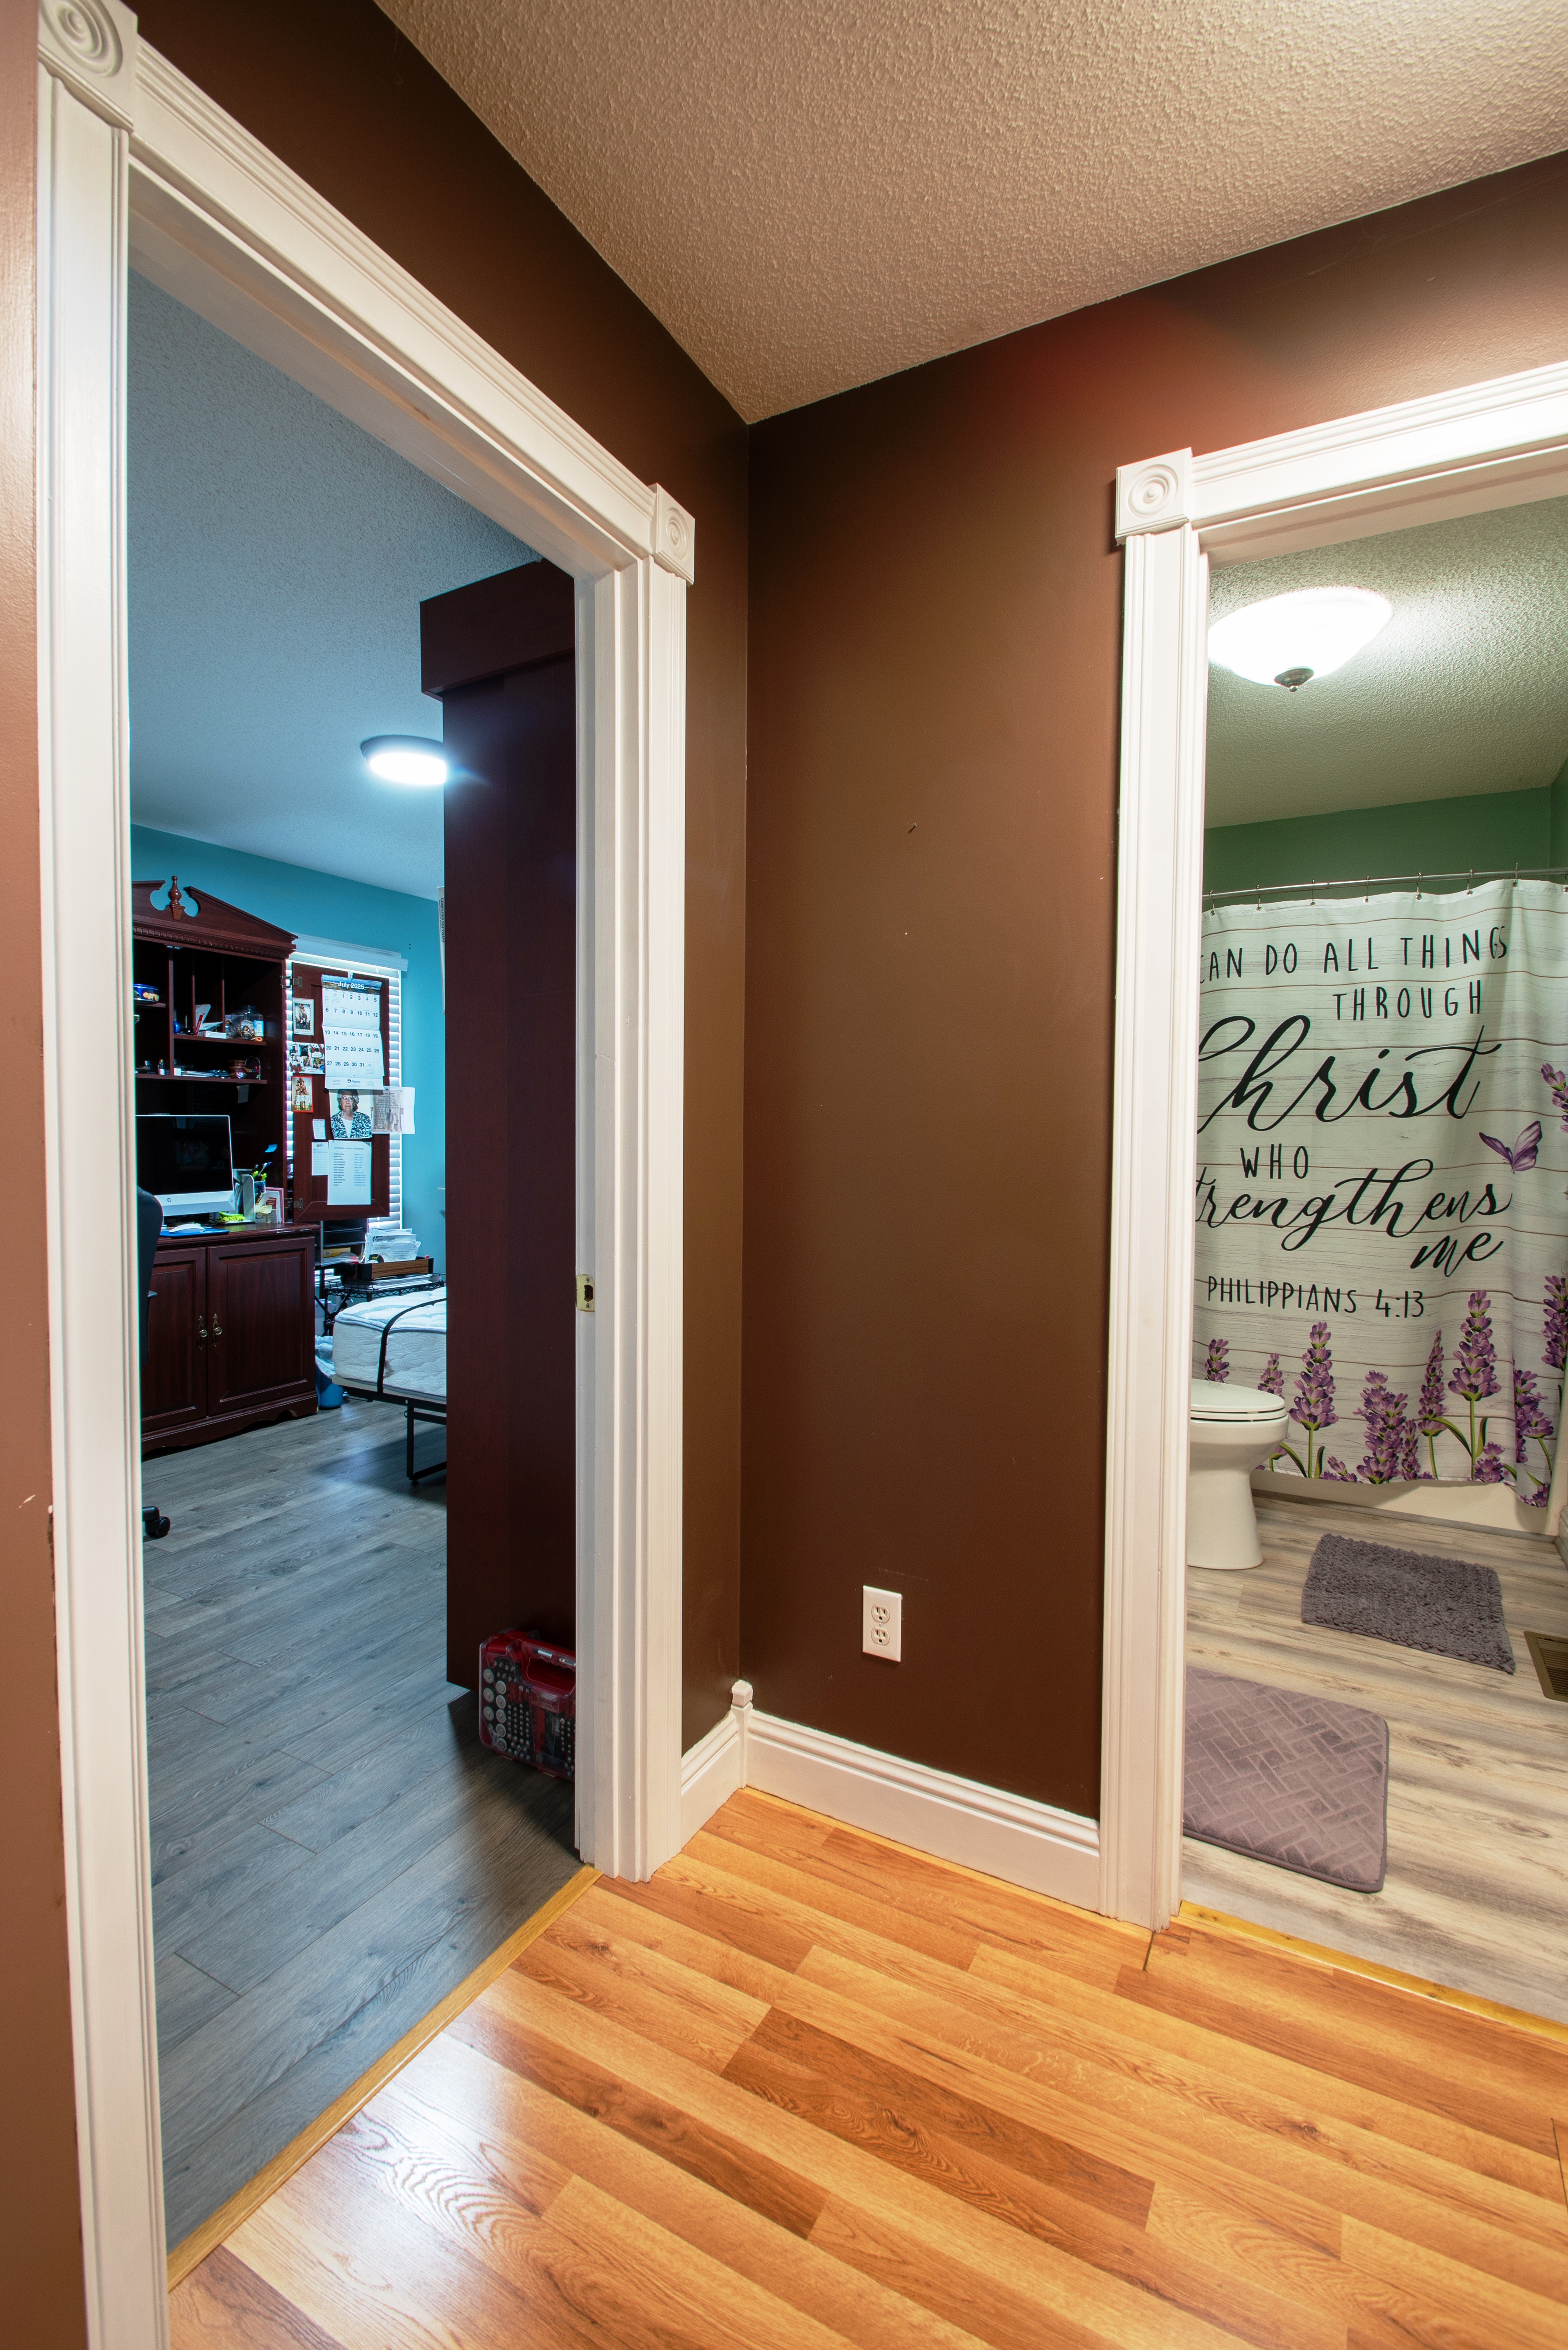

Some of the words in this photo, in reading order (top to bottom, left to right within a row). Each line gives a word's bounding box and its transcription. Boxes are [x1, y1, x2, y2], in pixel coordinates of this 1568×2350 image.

[1265, 943, 1298, 976] DO
[1323, 937, 1379, 974] ALL
[1400, 925, 1508, 969] THINGS
[1332, 979, 1481, 1021] THROUGH
[1239, 1143, 1309, 1180] WHO
[1196, 1159, 1513, 1251] trengthens
[1410, 1231, 1504, 1278] me
[1207, 1275, 1357, 1314] PHILIPPIANS
[1374, 1289, 1425, 1318] 4:13
